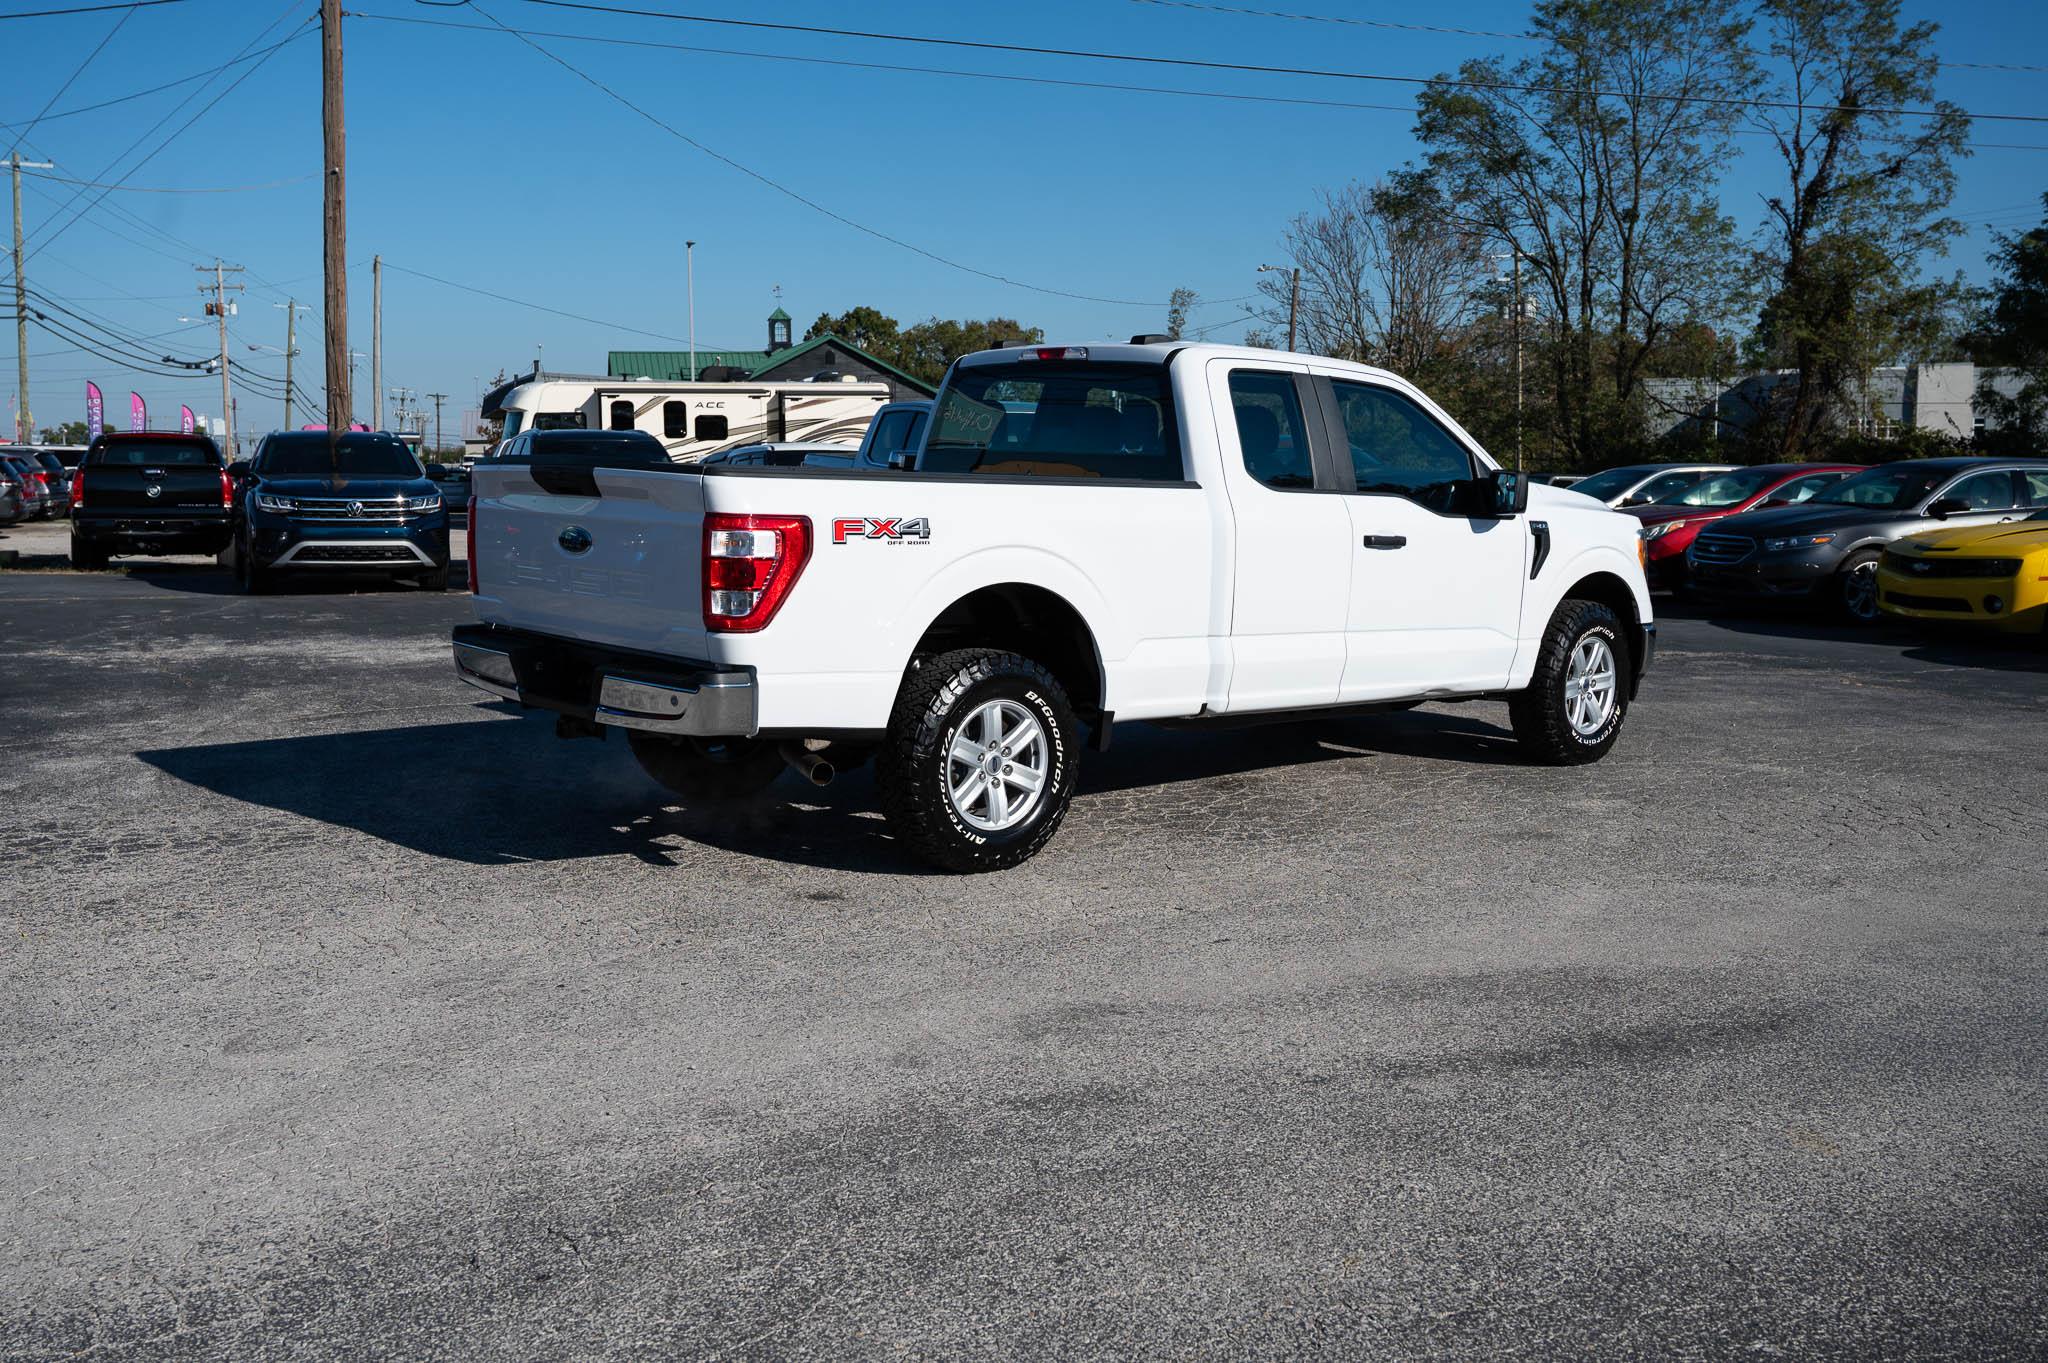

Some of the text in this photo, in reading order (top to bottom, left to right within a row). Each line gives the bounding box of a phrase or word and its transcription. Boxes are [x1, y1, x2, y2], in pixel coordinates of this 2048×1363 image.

[832, 517, 931, 545] FX4
[938, 727, 987, 845] All-Terrain T/A
[1025, 690, 1065, 794] BFGoodrich
